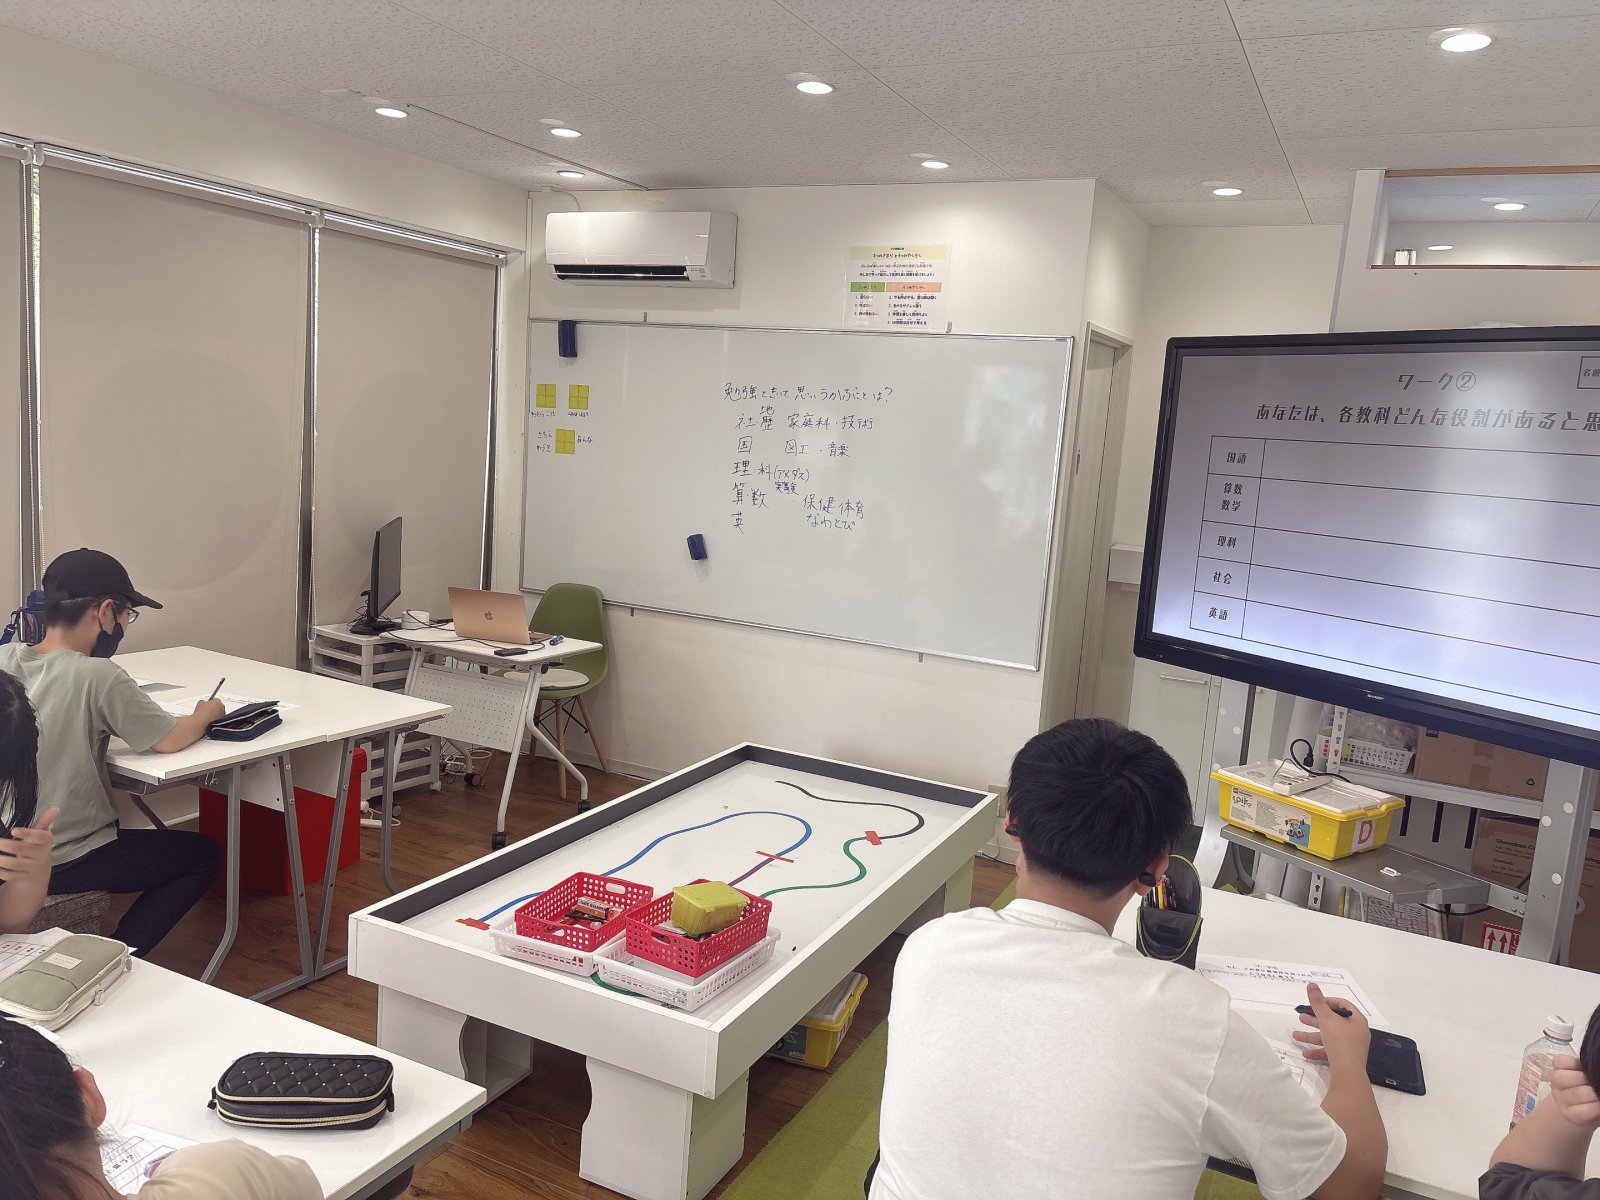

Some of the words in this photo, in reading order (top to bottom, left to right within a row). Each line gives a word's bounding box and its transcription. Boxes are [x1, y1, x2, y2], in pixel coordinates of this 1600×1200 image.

[1226, 451, 1248, 465] 国語
[1223, 482, 1244, 496] 算数
[1221, 499, 1242, 513] 数学
[1216, 535, 1237, 549] 理科
[1212, 571, 1233, 585] 社会
[1208, 606, 1229, 621] 英語
[1357, 819, 1373, 845] D
